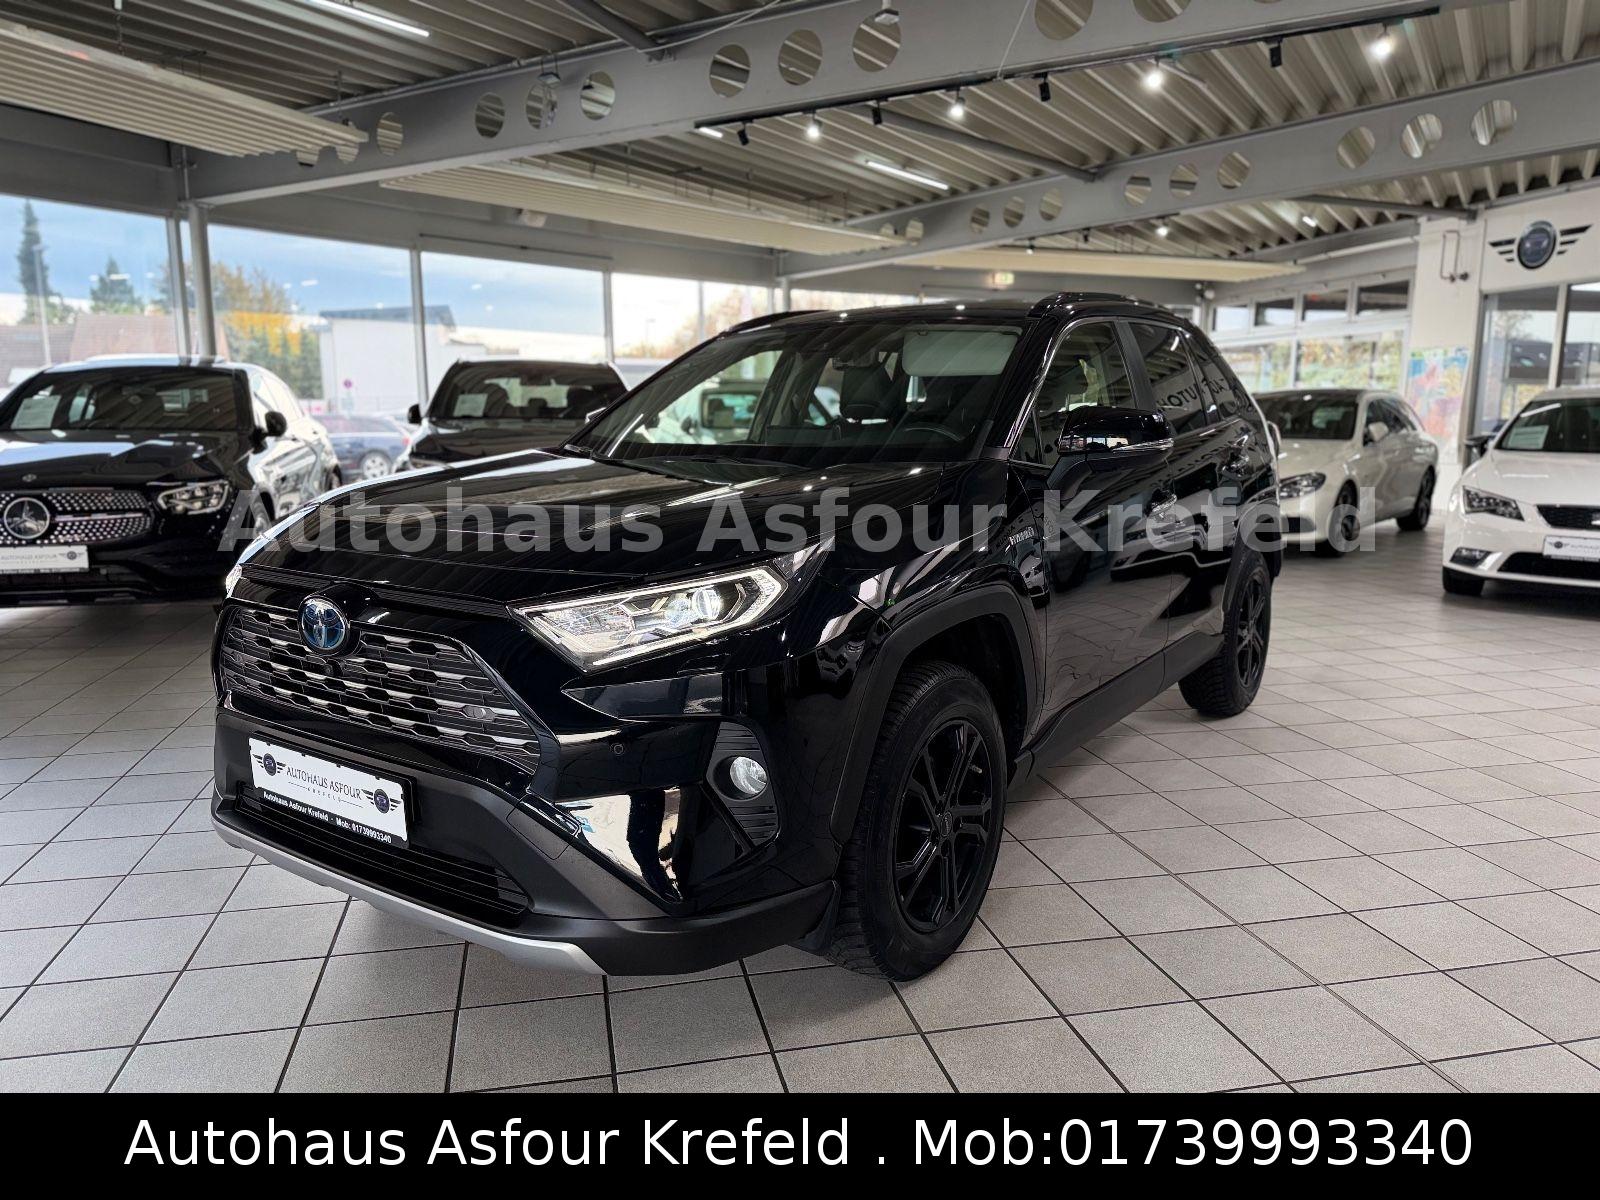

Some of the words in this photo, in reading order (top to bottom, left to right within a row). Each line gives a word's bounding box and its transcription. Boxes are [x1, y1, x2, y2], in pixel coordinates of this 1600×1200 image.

[286, 766, 328, 789] AUTOHAUS
[329, 781, 362, 800] ASFOUR
[263, 791, 288, 807] Autohaus
[288, 798, 307, 814] Asfour
[307, 805, 329, 821] Krefeld
[336, 817, 350, 830] Mob:
[351, 822, 392, 844] 01739993340
